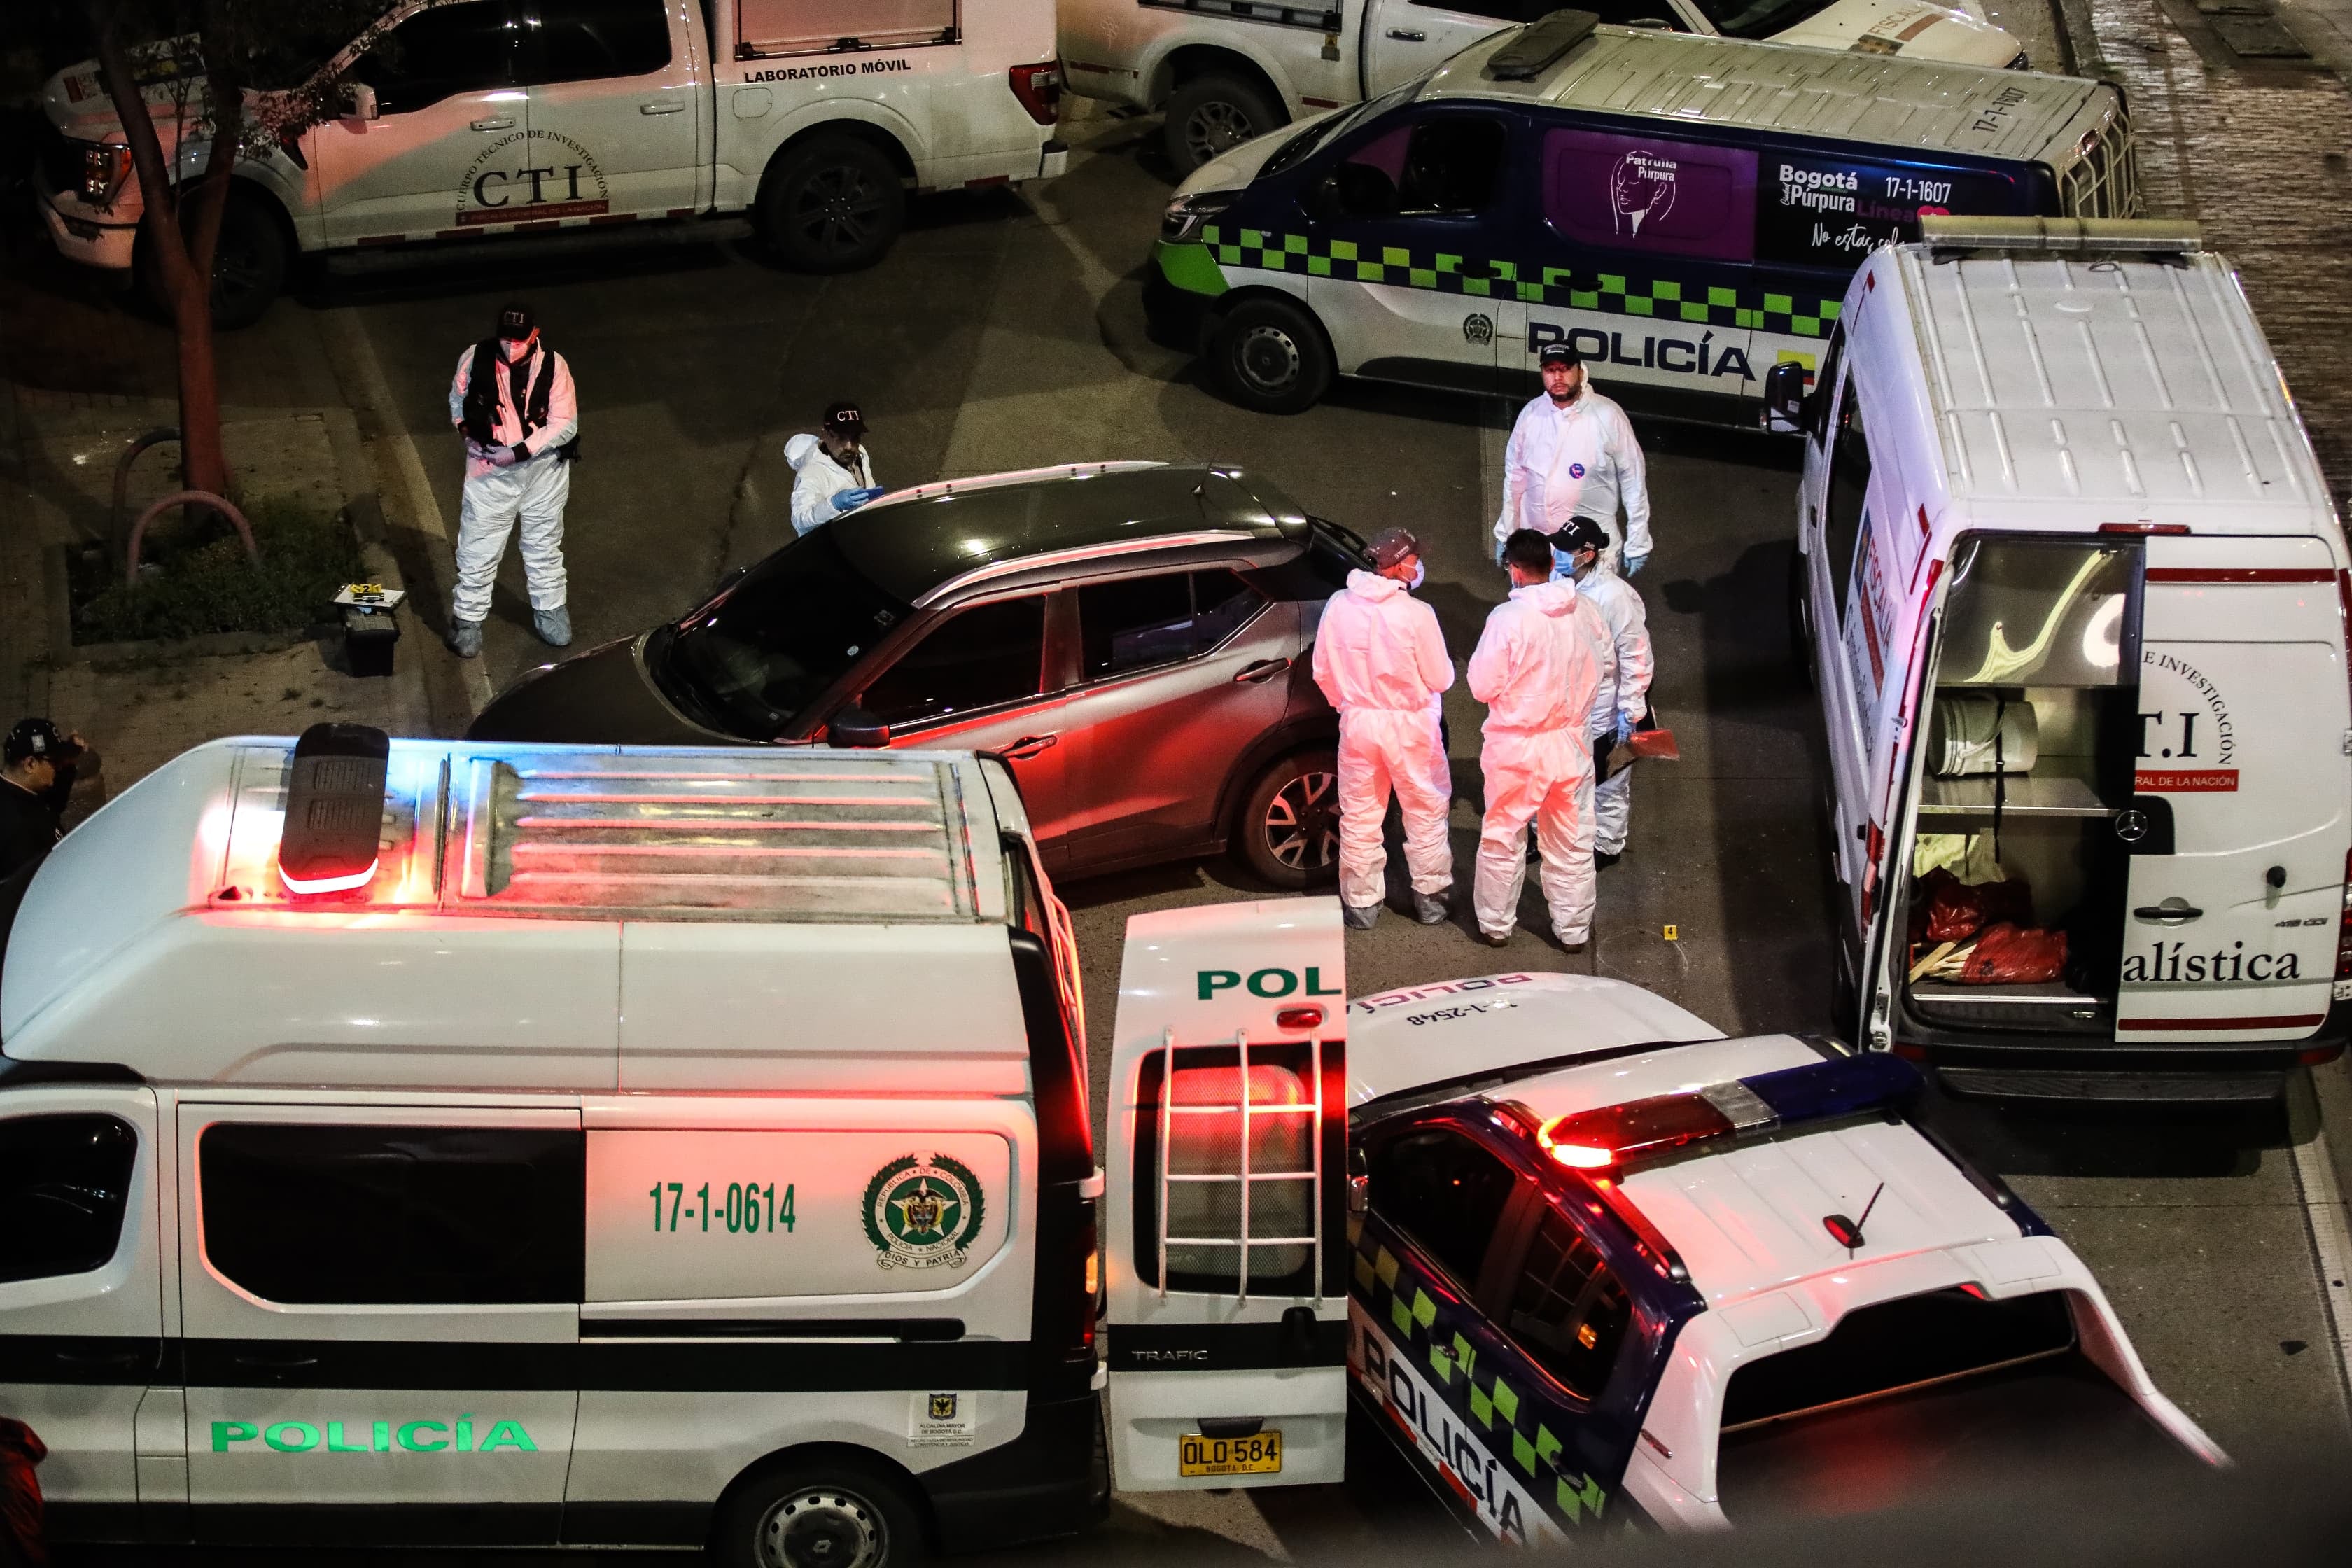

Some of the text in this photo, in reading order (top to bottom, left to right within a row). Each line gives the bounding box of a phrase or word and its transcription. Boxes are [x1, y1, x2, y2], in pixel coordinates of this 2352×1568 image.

[744, 59, 911, 83] LABORATORIO MÓVIL
[1972, 87, 2029, 132] 17-1-1607
[456, 130, 608, 211] CUERPO TÉCNICO DE INVESTIGACIÓN
[1779, 164, 1858, 190] Bogotá
[473, 165, 584, 207] CTI
[1791, 184, 1856, 214] Púrpura
[1885, 176, 1952, 204] 17-1-1607
[1856, 199, 1915, 223] Línea
[1812, 222, 1831, 247] No
[1877, 227, 1905, 248] sol
[504, 312, 525, 324] CTI
[1527, 322, 1757, 382] POLICÍA
[837, 410, 860, 421] CTI
[1562, 520, 1581, 536] TI
[2159, 654, 2236, 765] INVESTIGACIÓN
[2159, 777, 2174, 786] DE
[2176, 777, 2190, 785] LA
[2192, 776, 2235, 786] NACIÓN
[2122, 940, 2301, 982] alística
[1198, 967, 1343, 1000] POL
[1406, 999, 1518, 1026] -1-2548
[939, 1172, 969, 1205] COLOMBIA
[650, 1182, 796, 1233] 17-1-0614
[926, 1231, 959, 1252] NACIONAL
[885, 1251, 909, 1265] DIOS
[926, 1250, 960, 1266] PATRIA
[1131, 1350, 1208, 1361] TRAFIC
[211, 1412, 539, 1452] POLICÍA
[1362, 1325, 1529, 1548] POLICÍA
[1234, 1438, 1278, 1462] 584
